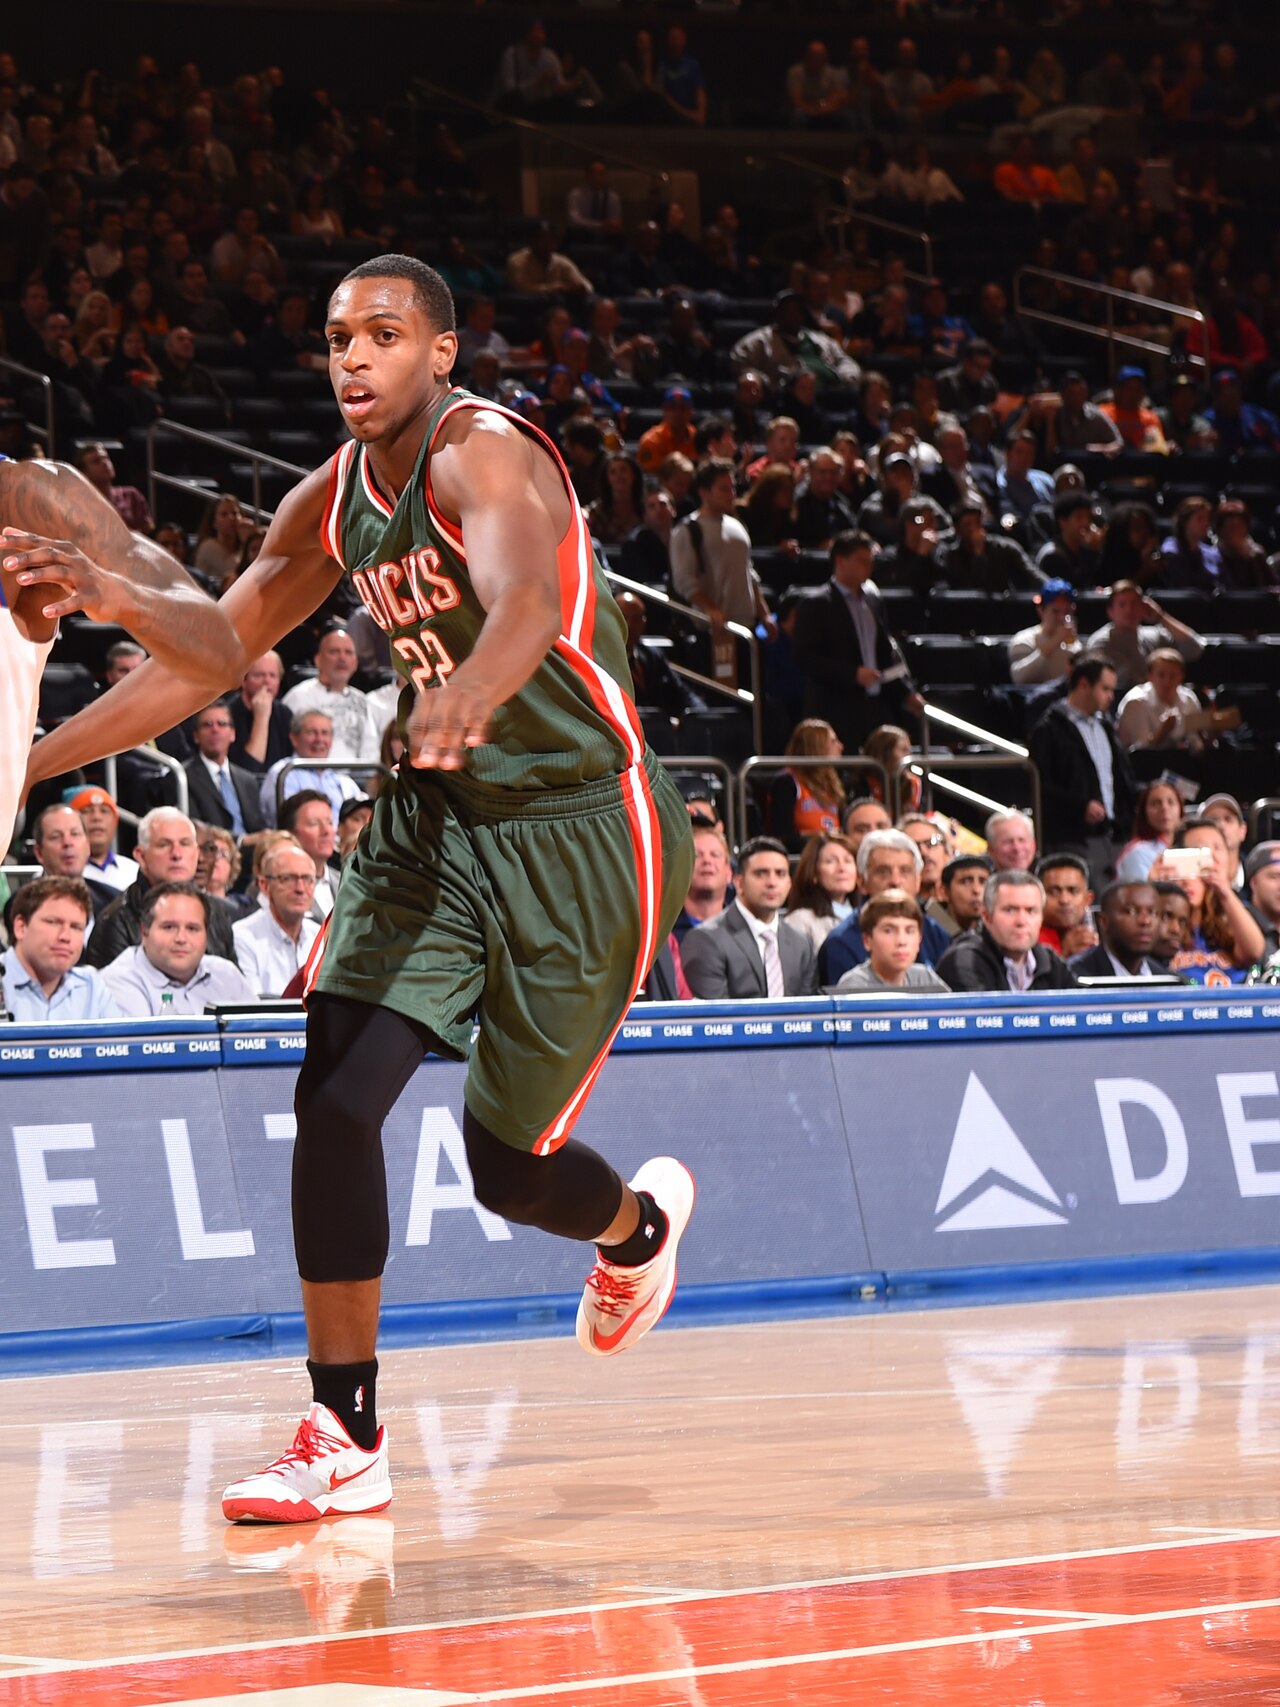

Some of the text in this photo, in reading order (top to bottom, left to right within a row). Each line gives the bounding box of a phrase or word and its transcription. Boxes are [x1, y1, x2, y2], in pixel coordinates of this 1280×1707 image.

[352, 545, 461, 633] BUCKS
[622, 1027, 652, 1037] CHASE
[663, 1025, 692, 1036] CHASE
[703, 1024, 733, 1035] CHASE
[743, 1023, 772, 1034] CHASE
[0, 1047, 34, 1059] CHASE
[48, 1046, 82, 1058] CHASE
[95, 1044, 129, 1056] CHASE
[142, 1042, 175, 1053] CHASE
[188, 1040, 220, 1051] CHASE
[233, 1039, 266, 1049] CHASE
[278, 1038, 305, 1048] CHAS
